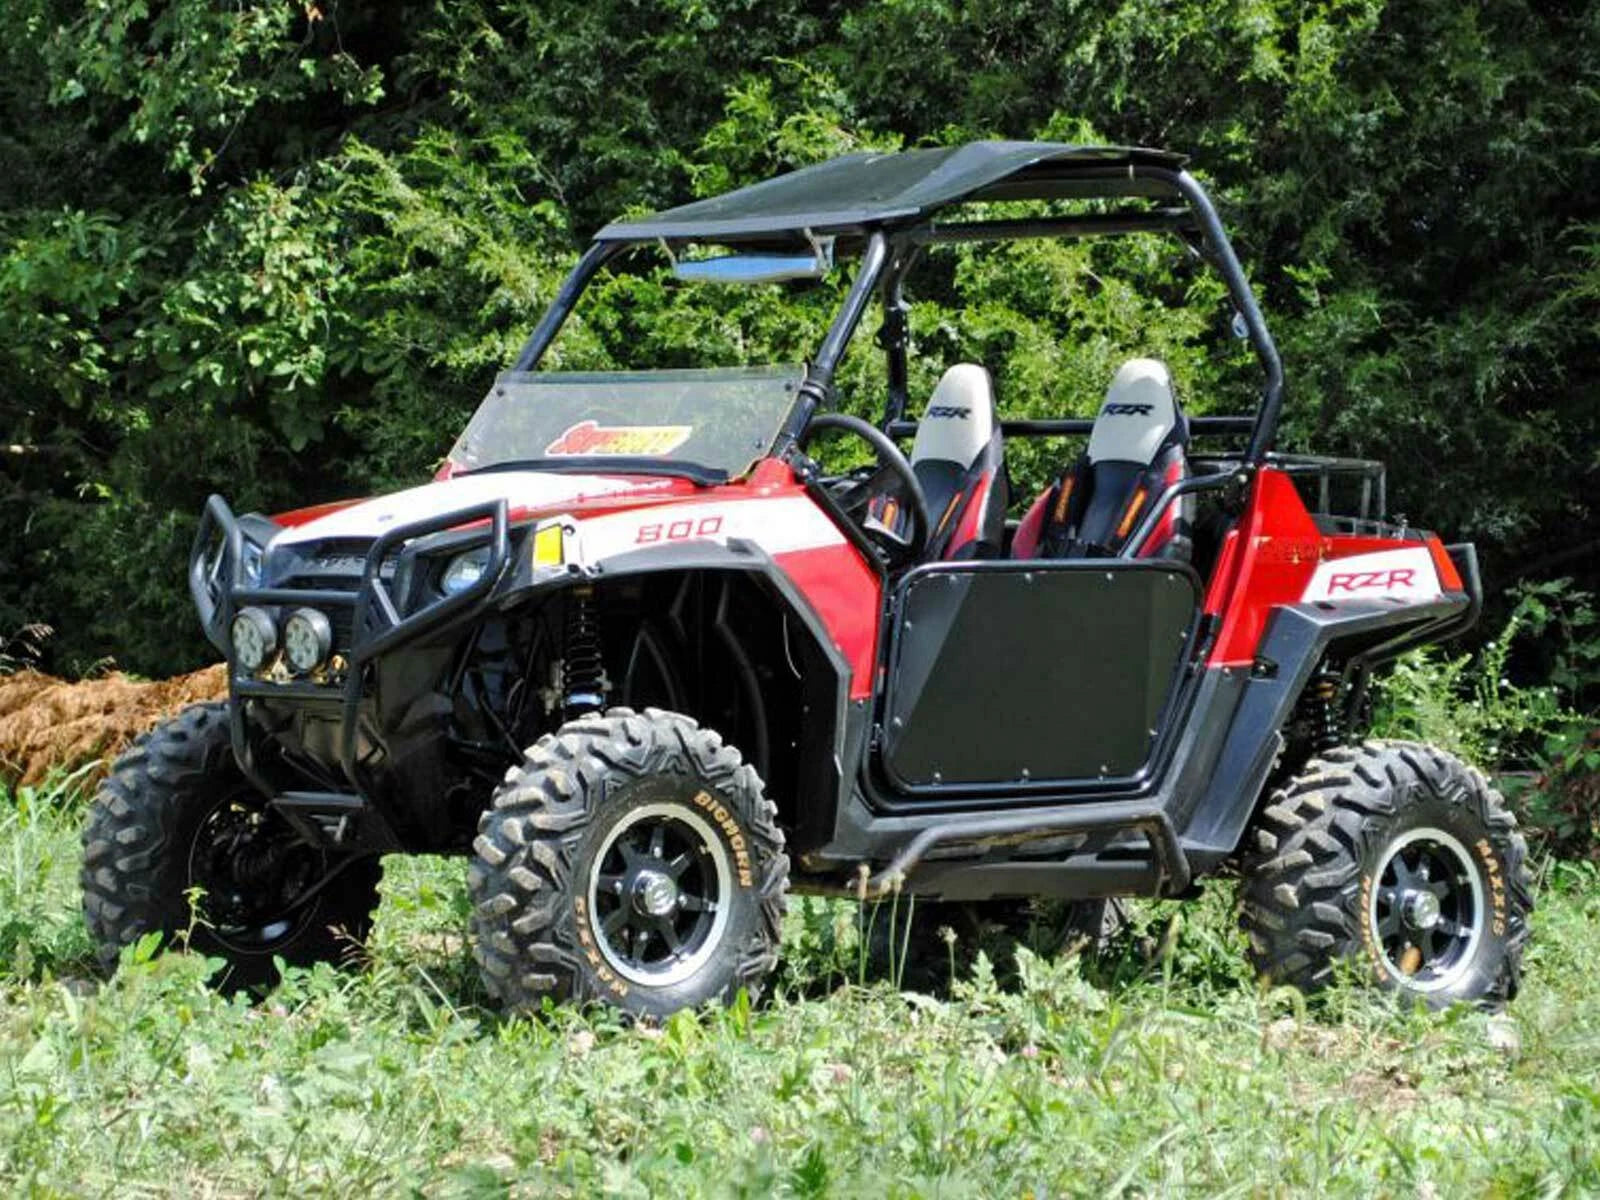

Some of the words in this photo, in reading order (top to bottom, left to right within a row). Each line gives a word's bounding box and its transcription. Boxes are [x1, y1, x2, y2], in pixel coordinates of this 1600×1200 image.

[634, 516, 723, 543] 800
[1327, 569, 1415, 595] RZR
[694, 790, 752, 886] BIGHORN
